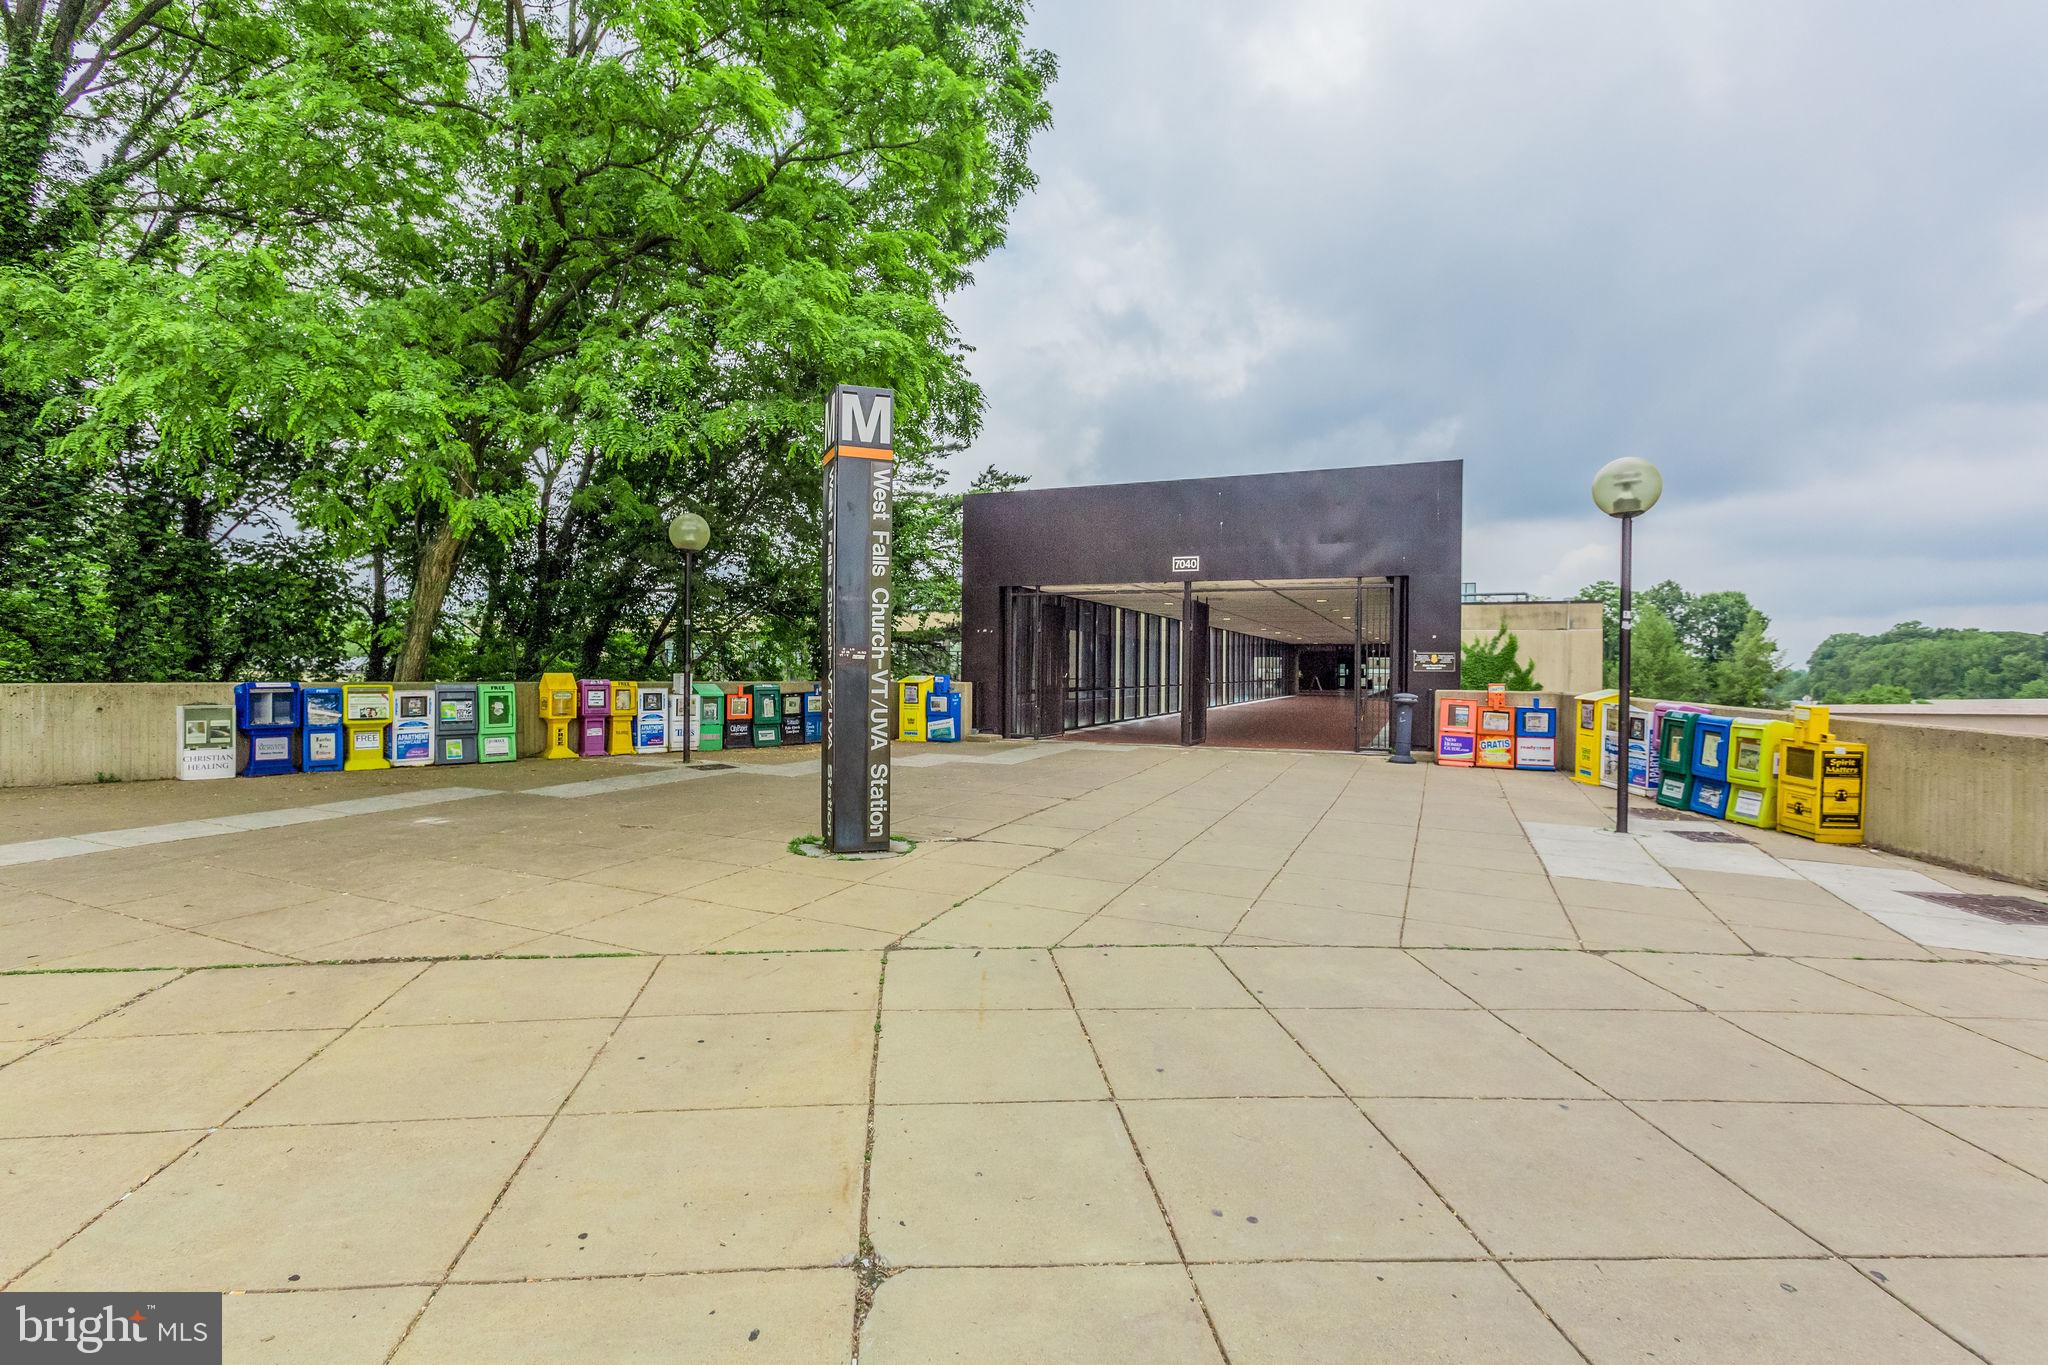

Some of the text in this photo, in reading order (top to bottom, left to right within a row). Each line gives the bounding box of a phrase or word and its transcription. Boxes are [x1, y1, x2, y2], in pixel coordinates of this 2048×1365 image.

[842, 393, 891, 444] M
[1175, 559, 1197, 569] 7040
[869, 469, 891, 837] West Falls Church-VT/UVA Station
[1480, 739, 1511, 750] GRATIS
[183, 754, 233, 762] CHRISTIAN
[1829, 758, 1857, 767] Spirit
[187, 762, 229, 771] HEALING
[1825, 766, 1859, 774] Matters
